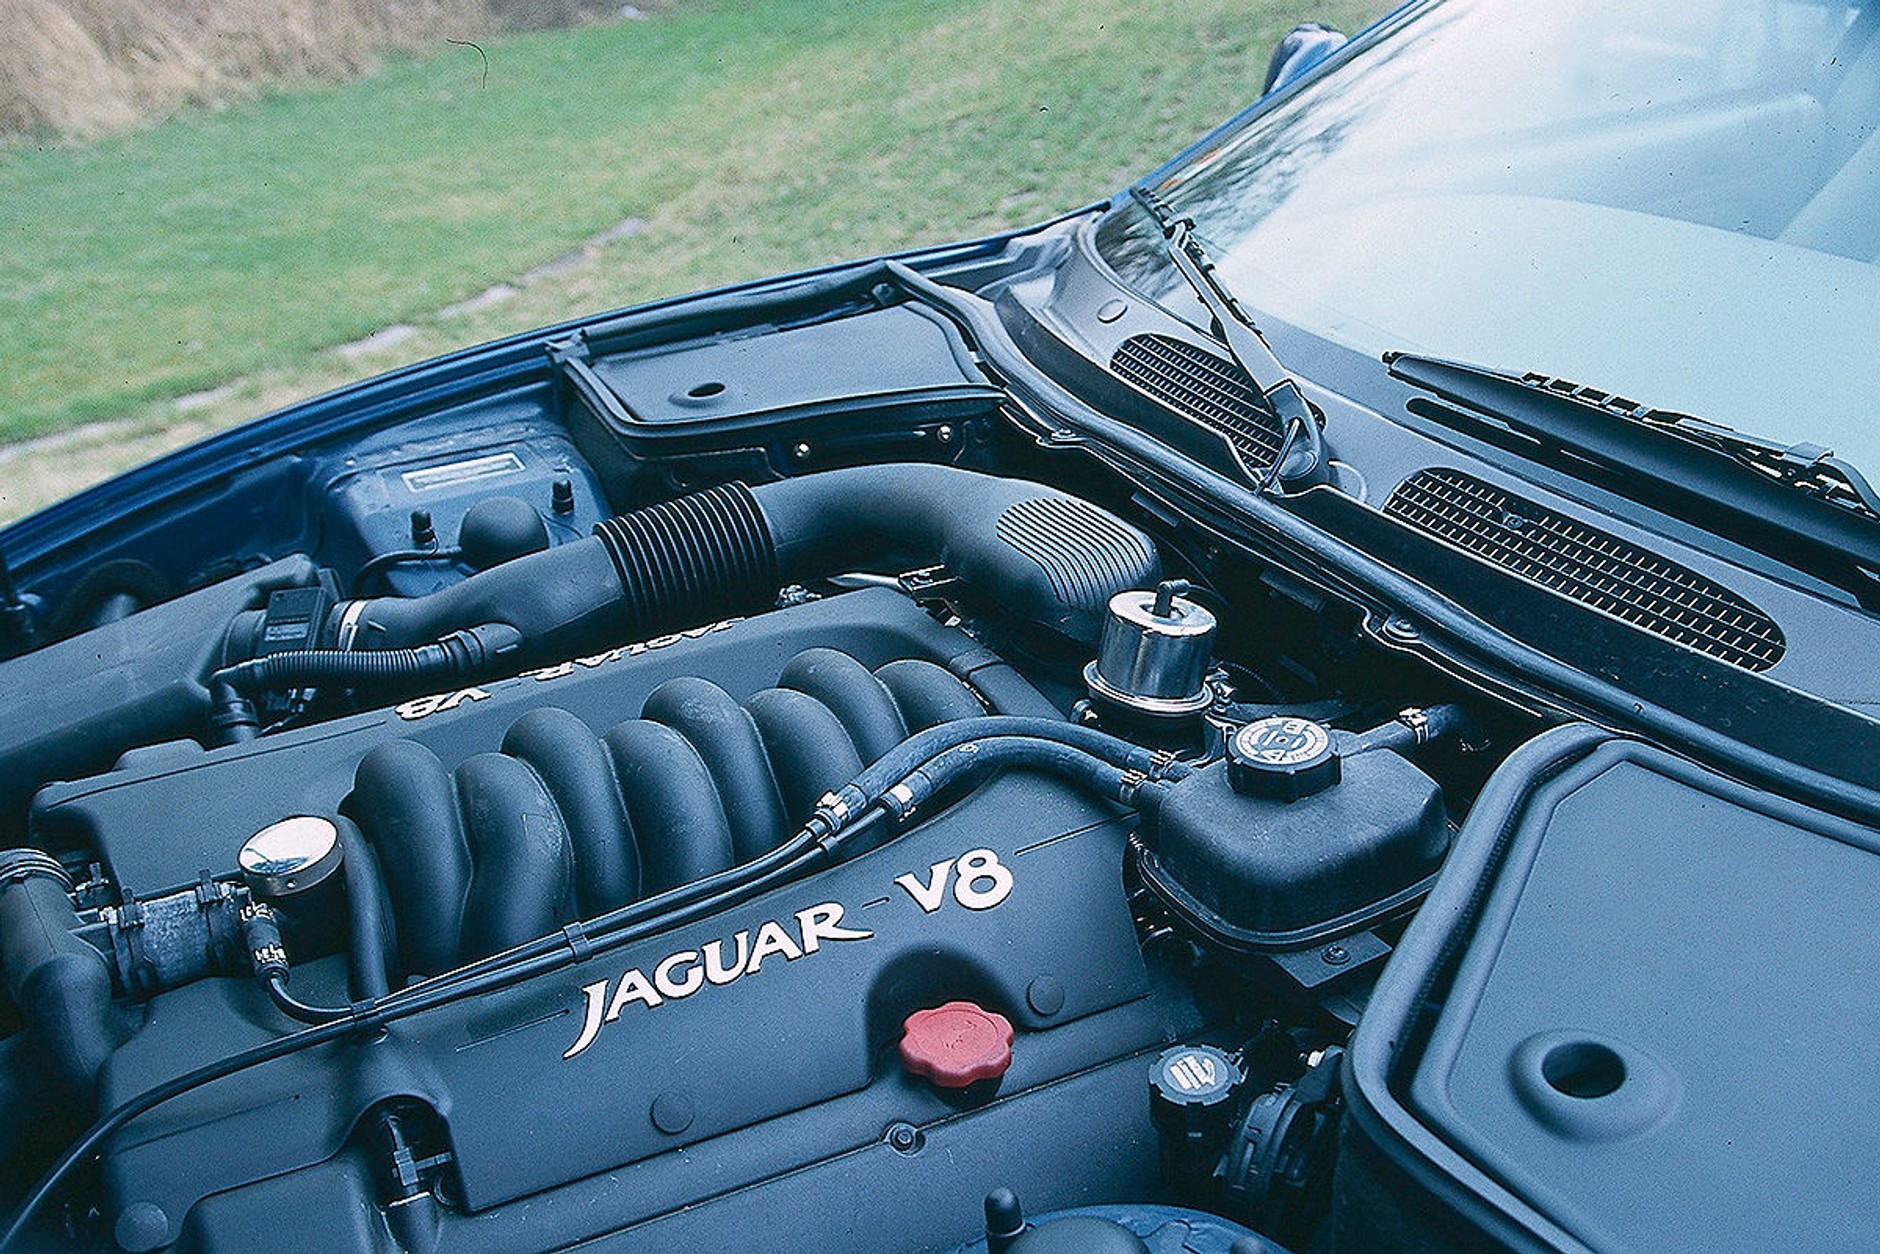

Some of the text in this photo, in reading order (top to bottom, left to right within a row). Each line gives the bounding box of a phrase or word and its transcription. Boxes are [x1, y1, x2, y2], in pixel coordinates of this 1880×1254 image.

[395, 686, 492, 719] V8
[563, 848, 1014, 1058] JAGUAR V8
